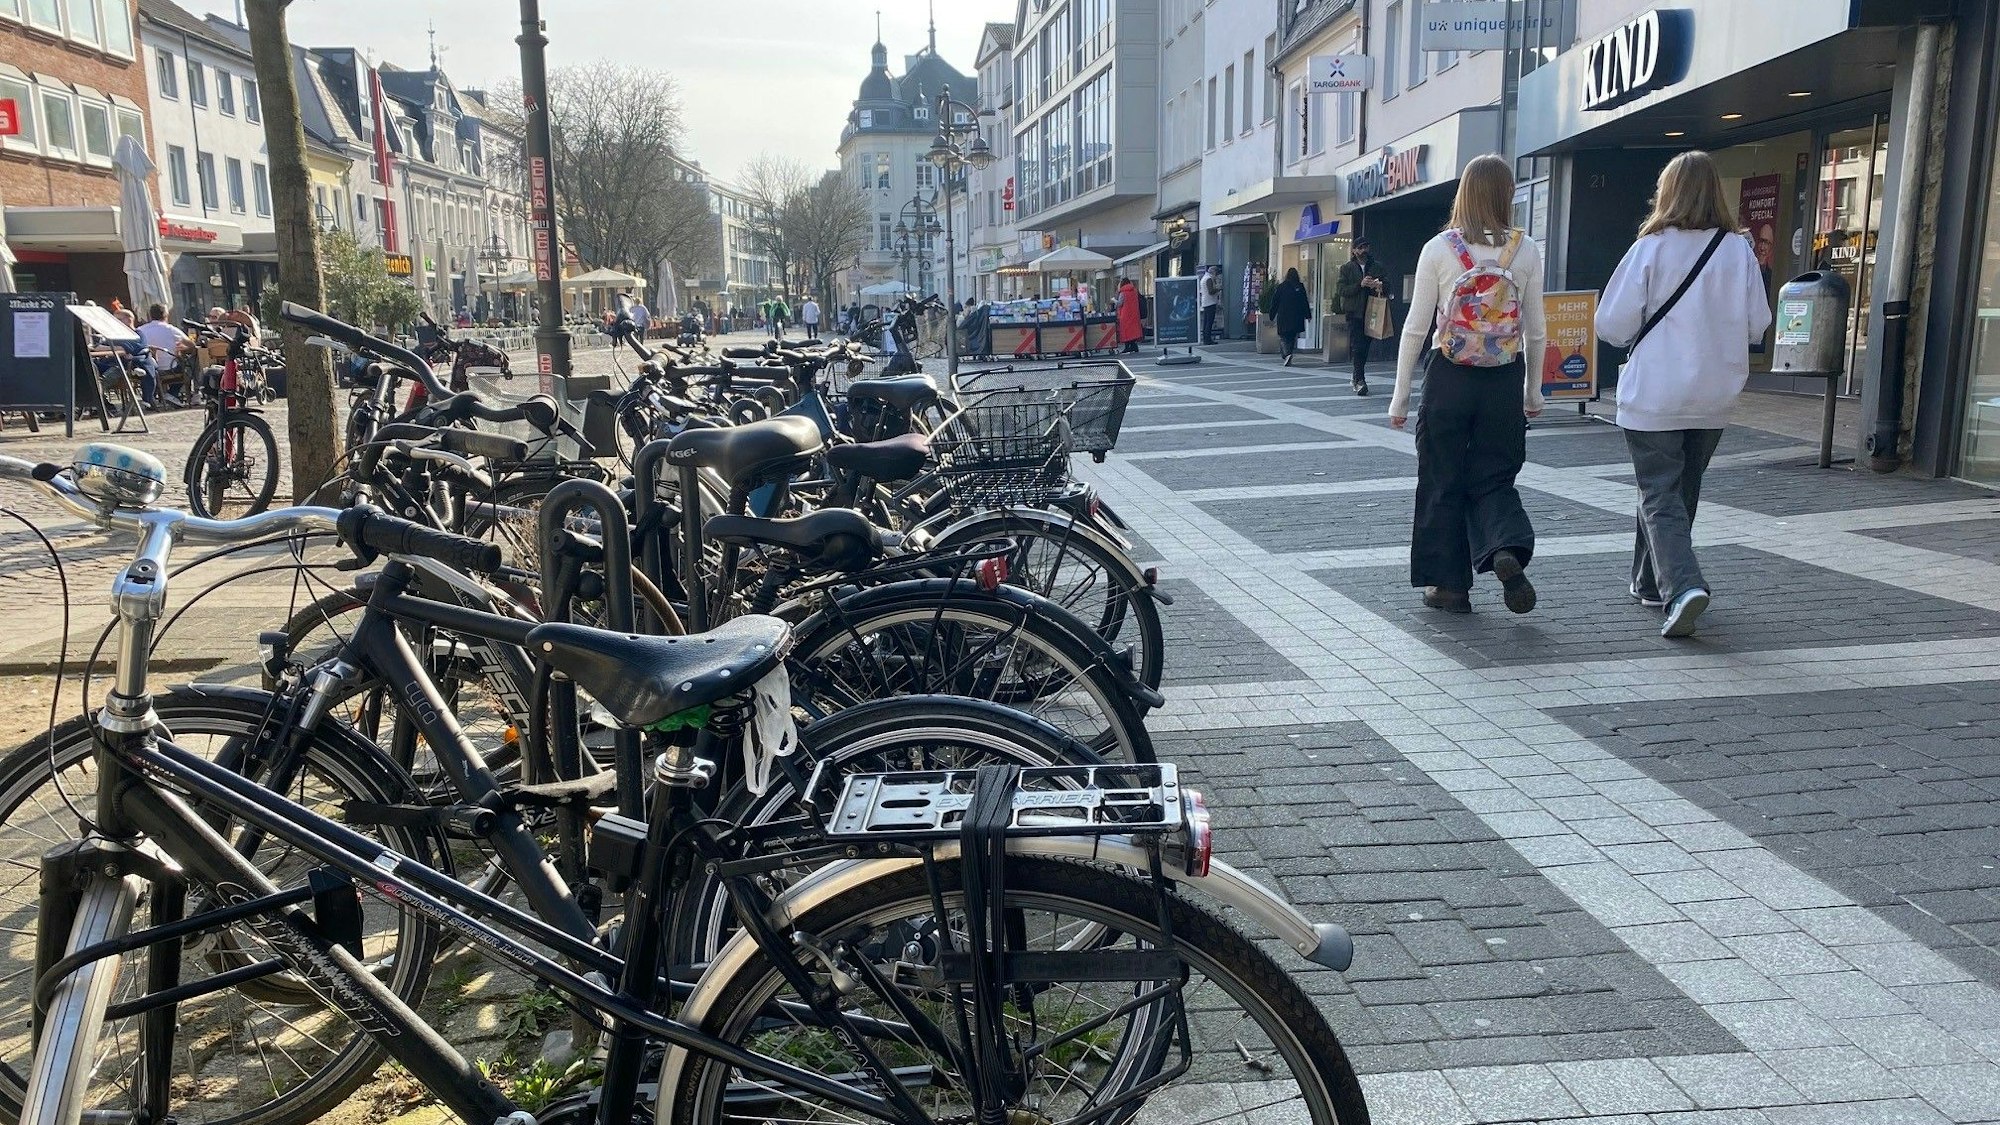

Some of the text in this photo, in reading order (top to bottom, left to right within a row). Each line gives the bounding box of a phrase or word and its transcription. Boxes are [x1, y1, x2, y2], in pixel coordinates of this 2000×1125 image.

[1579, 9, 1660, 112] KIND
[1313, 80, 1361, 88] TARGOBANK
[1590, 174, 1605, 188] 21
[1750, 210, 1774, 221] SPECIAL
[1831, 247, 1857, 259] KIND
[9, 299, 54, 309] Markt 20
[1557, 301, 1588, 312] MEHR
[1545, 312, 1588, 322] RSTEHEN
[1557, 327, 1588, 337] MEHR
[1572, 382, 1588, 390] KIND
[469, 645, 530, 742] FISCH
[405, 680, 437, 724] cyco
[1012, 793, 1096, 806] ARRIER
[831, 1025, 896, 1098] GIANT
